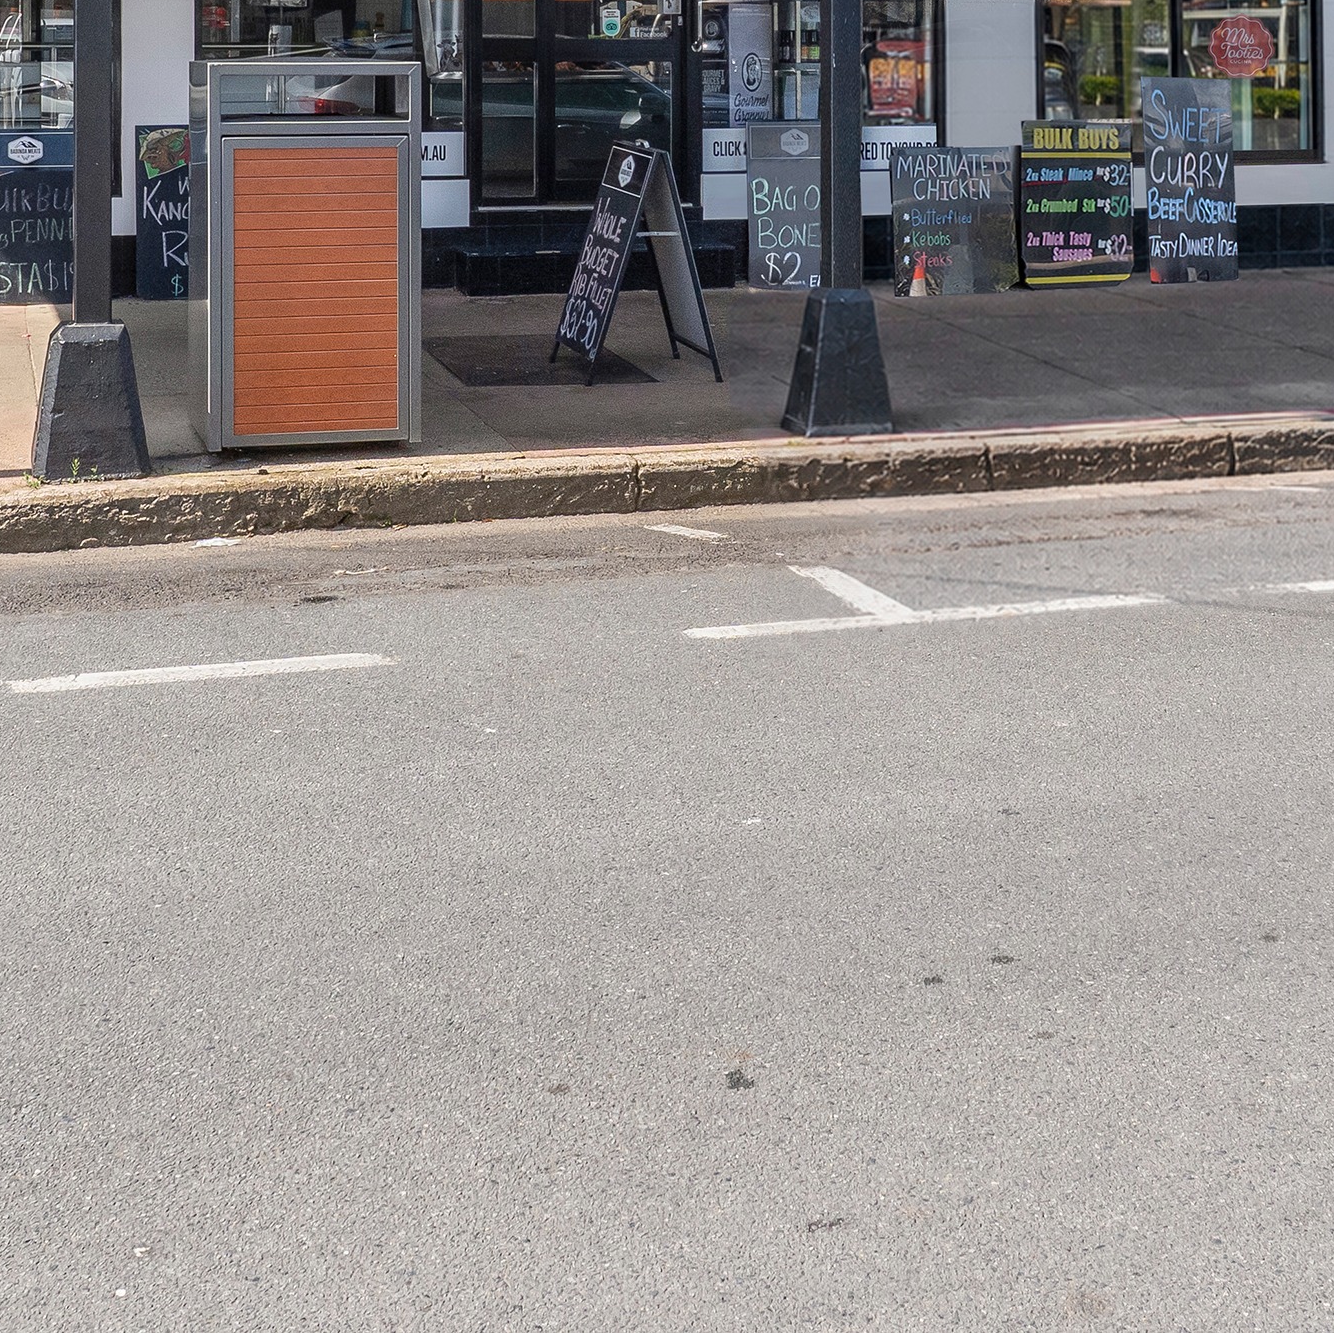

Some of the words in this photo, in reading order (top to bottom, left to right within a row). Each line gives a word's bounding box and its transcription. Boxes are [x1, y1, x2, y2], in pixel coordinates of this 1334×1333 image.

[1221, 27, 1255, 45] Mrs
[1149, 89, 1227, 144] SWEET
[713, 141, 741, 157] CLICK
[861, 142, 877, 161] RED
[1033, 128, 1074, 150] BULK
[1078, 128, 1120, 150] BUYS
[897, 153, 1007, 179] MARINATED
[1040, 168, 1064, 181] Steak
[1068, 167, 1094, 181] Mince
[1150, 145, 1228, 189] CURRY
[37, 183, 73, 212] BU
[751, 177, 796, 215] BAG
[804, 184, 821, 211] O
[913, 178, 990, 201] CHICKEN
[911, 208, 972, 227] Butterflied
[1041, 198, 1078, 213] Crumbed
[1148, 187, 1184, 222] BEEF
[593, 197, 627, 244] WHOLE
[757, 217, 821, 250] BONE
[1042, 231, 1065, 246] Thick
[1069, 231, 1093, 247] Tasty
[1149, 235, 1178, 259] TASTY
[1179, 232, 1215, 258] DINNER
[580, 234, 619, 278] BUDGET
[44, 259, 73, 292] $1
[569, 261, 588, 300] RIB
